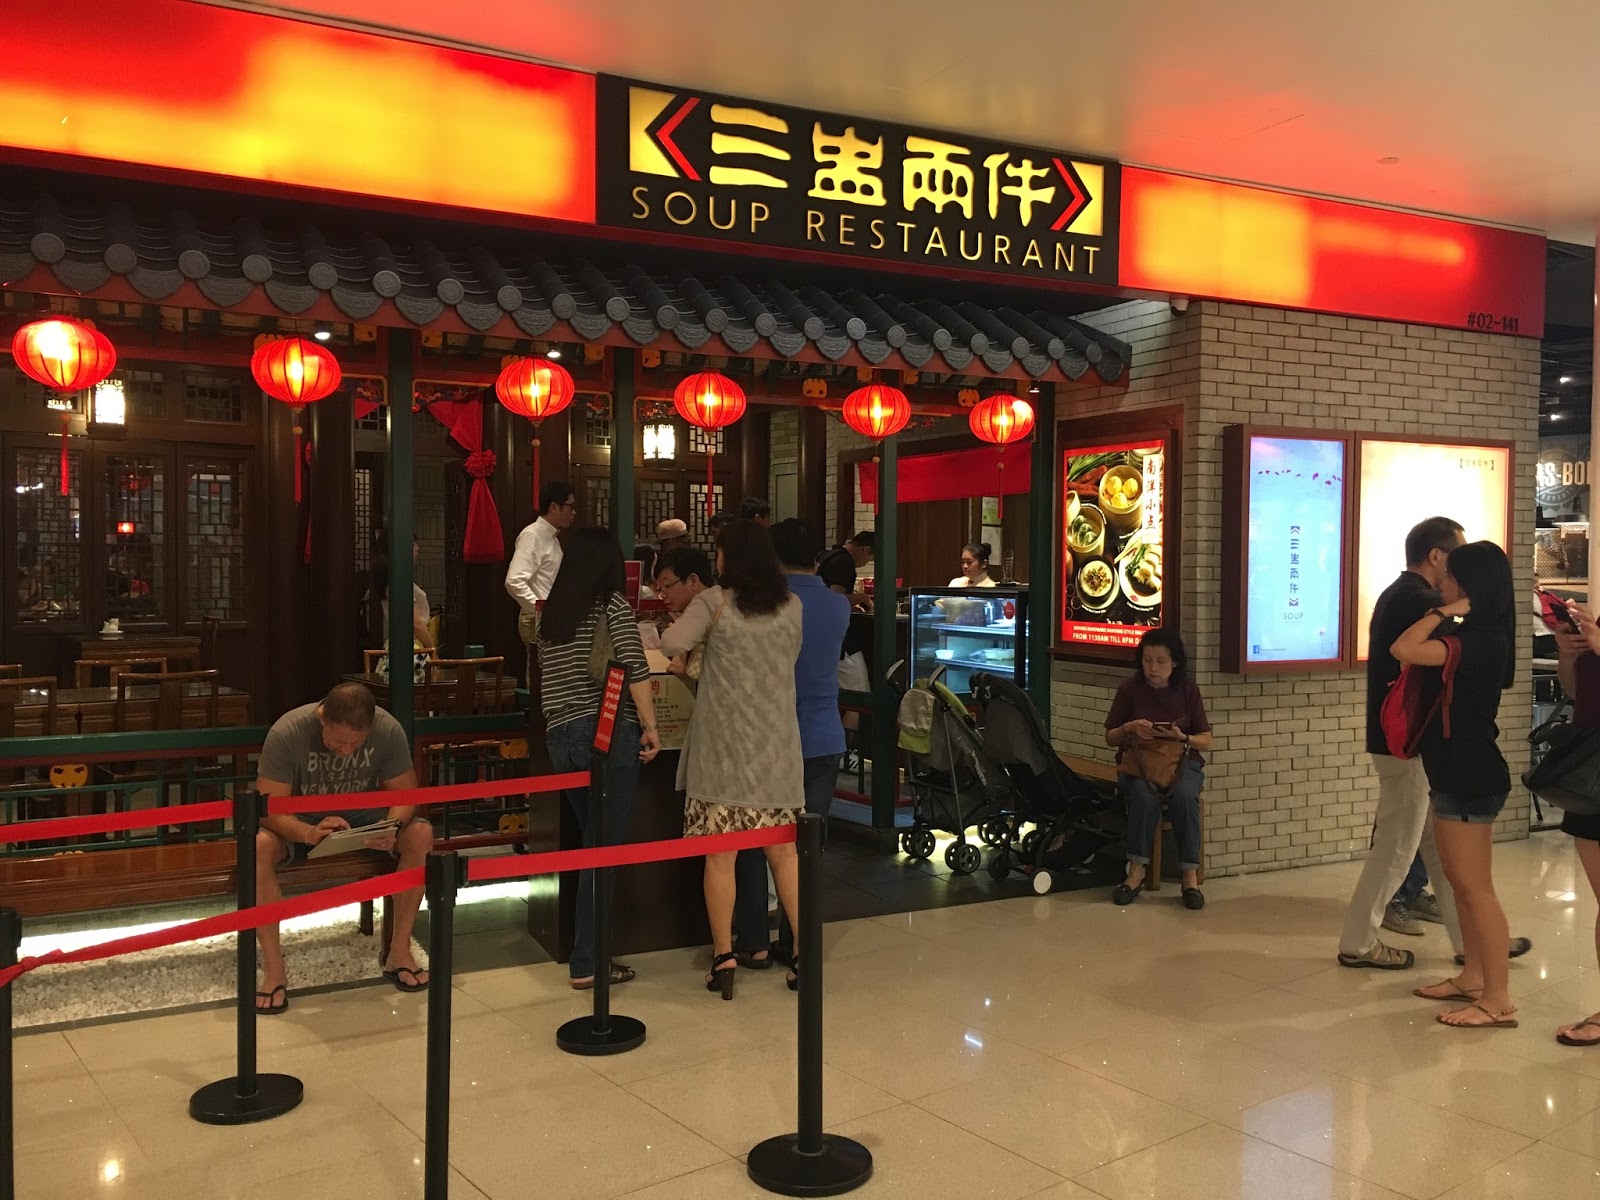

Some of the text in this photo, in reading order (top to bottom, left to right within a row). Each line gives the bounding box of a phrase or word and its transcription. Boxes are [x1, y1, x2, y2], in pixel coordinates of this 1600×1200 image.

[631, 185, 1101, 275] SOUP RESTAURANT
[1467, 311, 1519, 332] #02-141
[1283, 612, 1304, 620] SOUP
[1110, 635, 1121, 643] TILL
[1122, 637, 1134, 645] 8PM
[307, 747, 375, 772] BRONX
[334, 776, 371, 795] YORK
